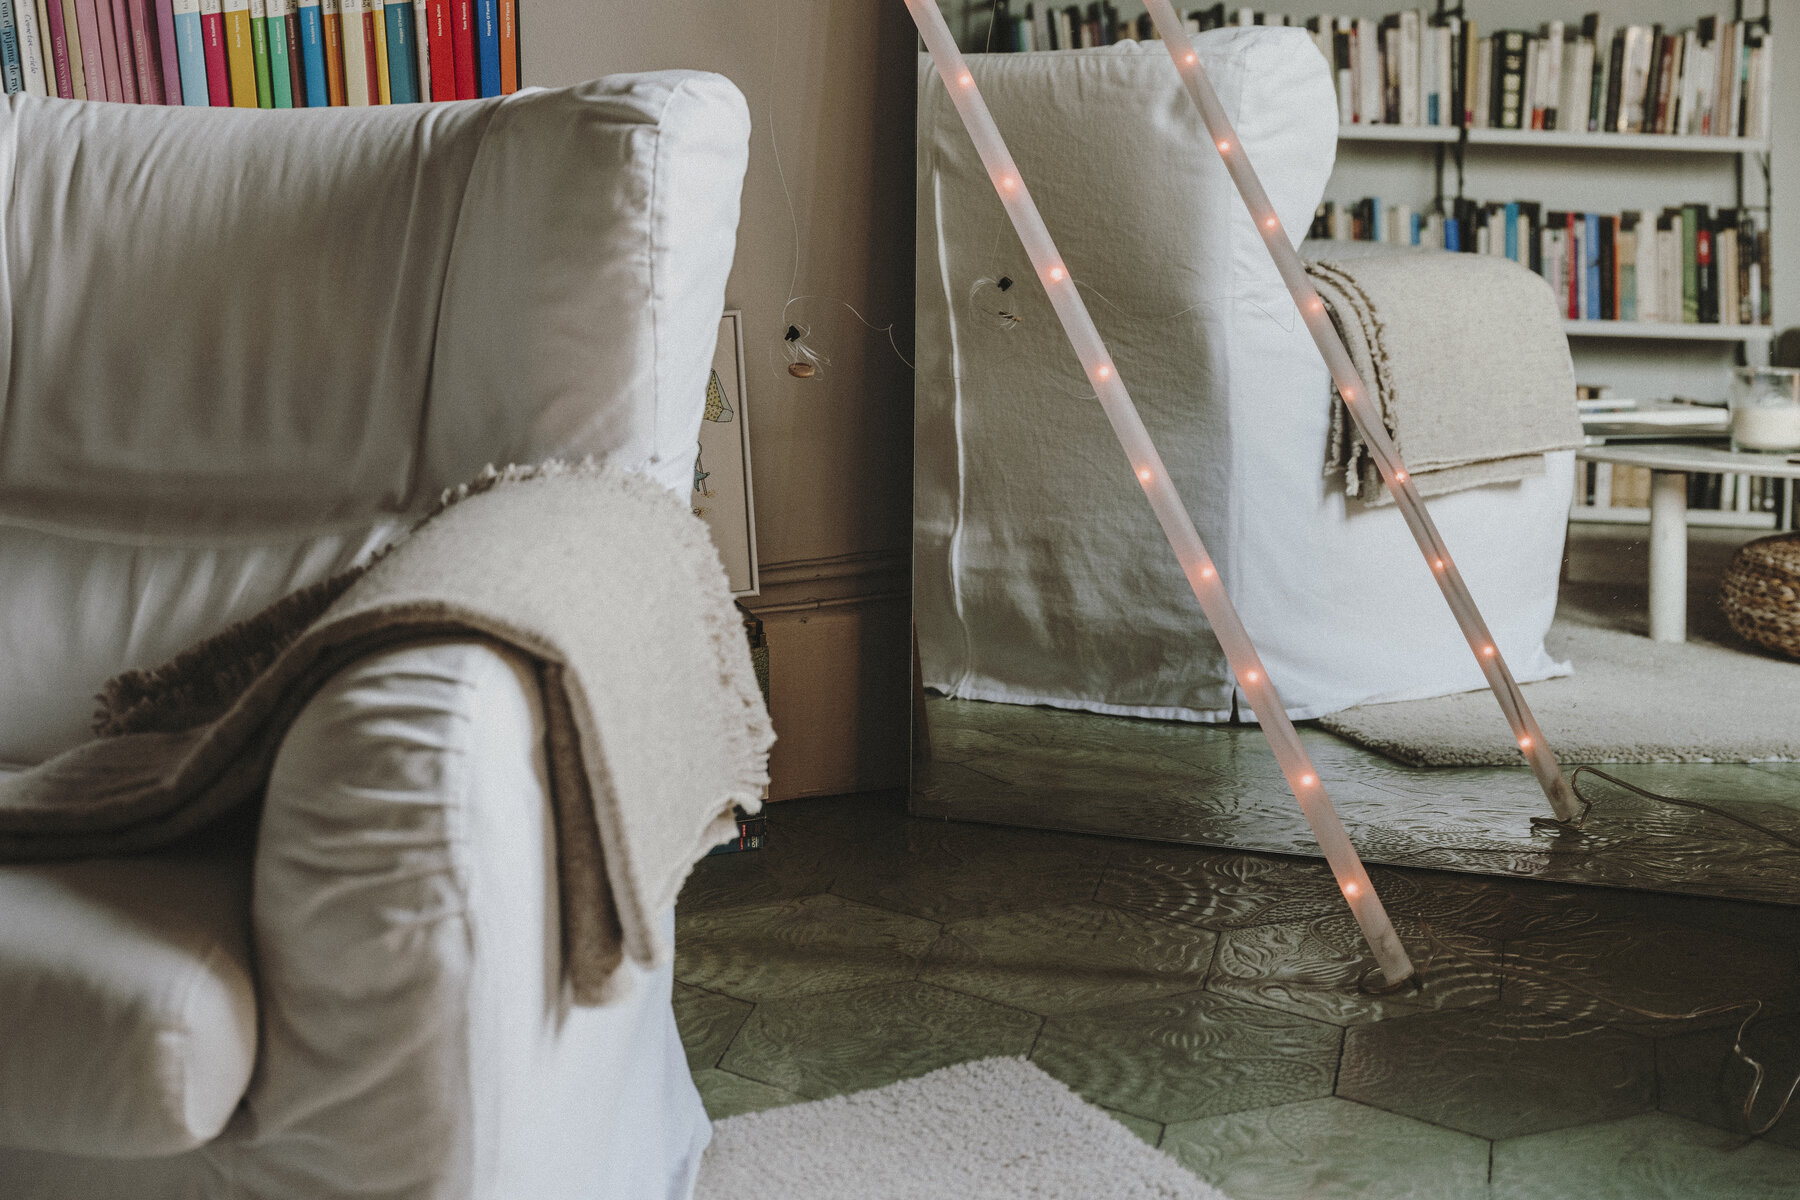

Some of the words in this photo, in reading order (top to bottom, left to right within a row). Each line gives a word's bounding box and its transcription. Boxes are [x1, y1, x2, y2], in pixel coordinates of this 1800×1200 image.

[3, 19, 12, 28] el
[3, 29, 15, 60] pijama
[9, 62, 18, 75] de
